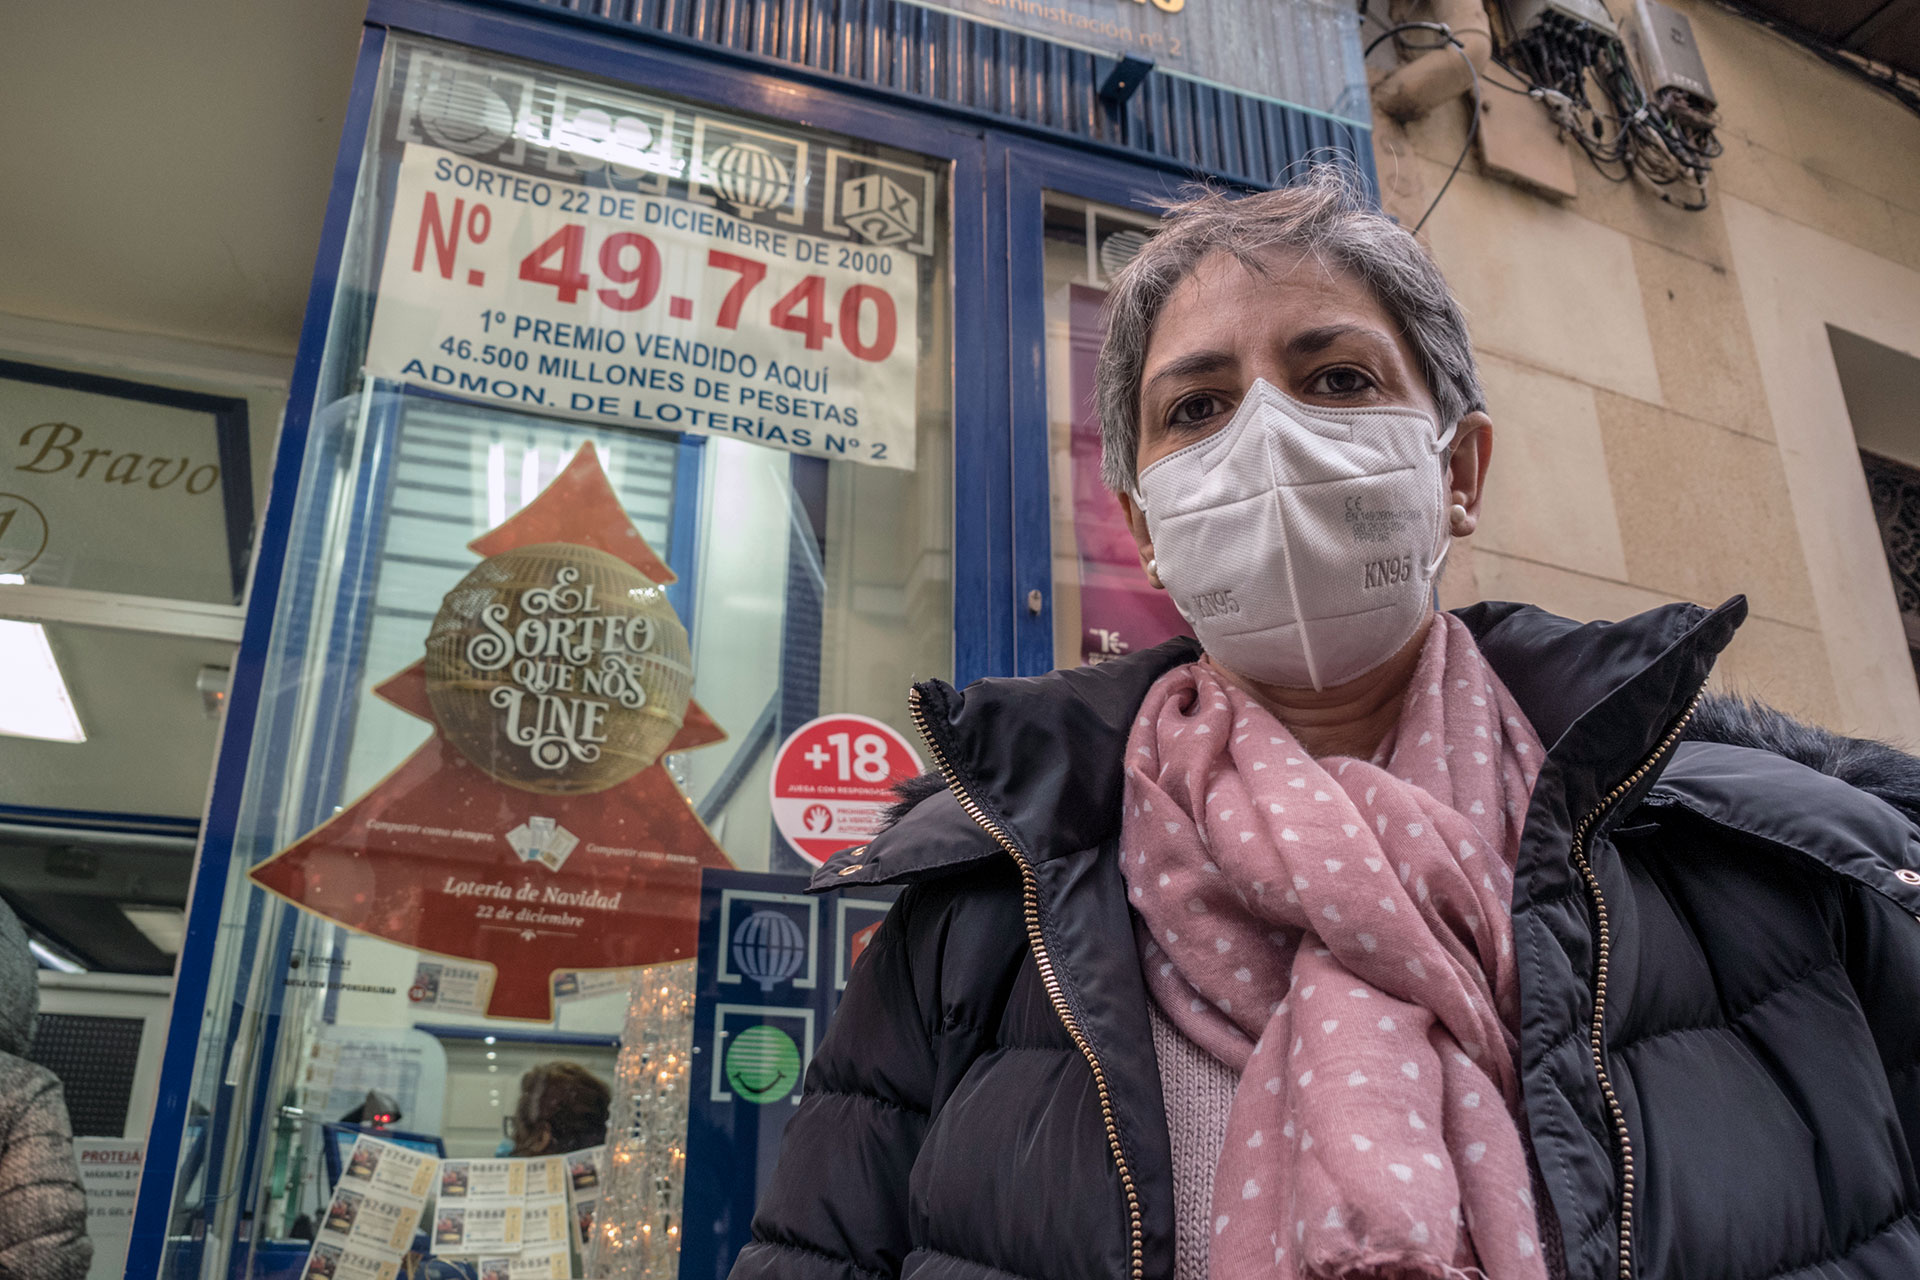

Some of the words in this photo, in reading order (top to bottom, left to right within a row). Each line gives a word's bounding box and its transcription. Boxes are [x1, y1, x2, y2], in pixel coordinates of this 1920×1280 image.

[988, 0, 1133, 42] ministración
[1169, 37, 1182, 57] 2
[434, 157, 552, 207] SORTEO
[559, 188, 591, 214] 22
[598, 195, 636, 221] DE
[644, 201, 788, 258] DICIEMBRE
[795, 238, 830, 266] DE
[837, 247, 893, 276] 2000
[517, 222, 898, 363] 49.740
[479, 308, 507, 334] 1º
[513, 314, 625, 355] PREMIO
[635, 332, 758, 379] VENDIDO
[763, 360, 830, 394] AQUÍ
[400, 358, 556, 408] ADMON.
[570, 392, 621, 416] DE
[633, 400, 813, 448] LOTERÍAS
[825, 433, 861, 454] Nº
[869, 442, 889, 460] 2
[439, 335, 529, 372] 46.500
[538, 354, 685, 393] MILLONES
[694, 377, 731, 403] DE
[739, 386, 859, 428] PESETAS
[15, 421, 221, 496] Bravo
[520, 566, 601, 616] EL
[1364, 555, 1411, 589] KN95
[1191, 589, 1240, 618] KN95
[466, 603, 656, 672] SORTEO
[511, 657, 576, 695] QUE
[581, 654, 647, 710] NOS
[489, 685, 610, 770] UNE
[804, 732, 891, 783] +18
[817, 785, 836, 794] CON
[442, 876, 513, 898] Lotería
[515, 882, 540, 901] de
[542, 886, 623, 911] Navidad
[475, 904, 495, 919] 22
[495, 905, 514, 921] de
[515, 907, 586, 928] diciembre
